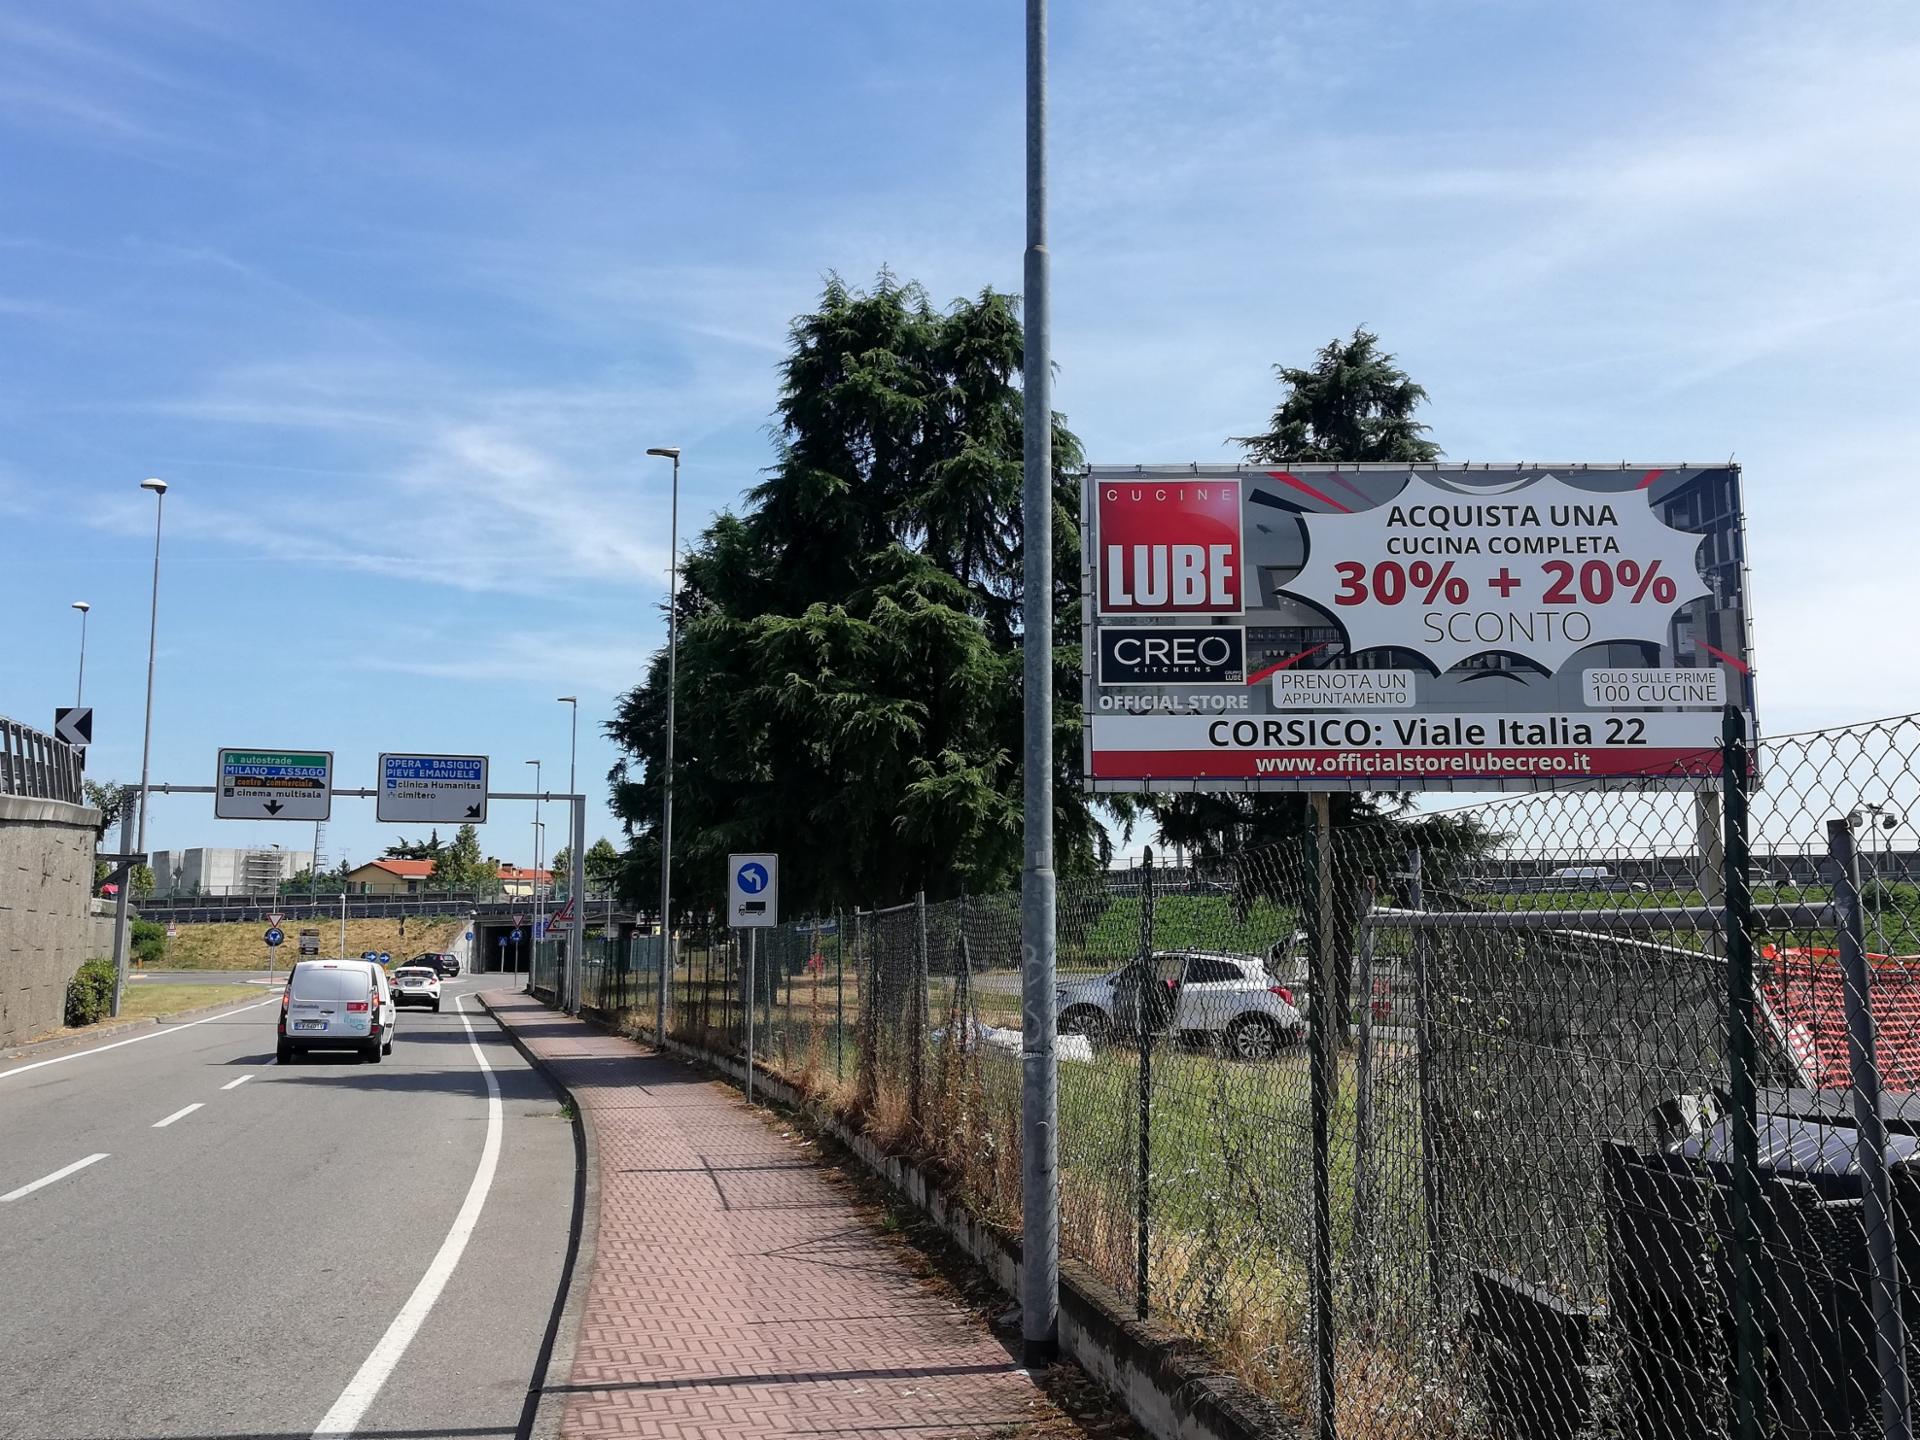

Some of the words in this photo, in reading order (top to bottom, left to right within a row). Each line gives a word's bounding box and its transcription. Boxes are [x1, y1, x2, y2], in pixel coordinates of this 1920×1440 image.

[1107, 489, 1232, 502] CUCINE
[1386, 504, 1541, 532] ACQUISTA
[1550, 504, 1619, 527] UNA
[1386, 536, 1481, 555] CUCINA
[1487, 536, 1621, 554] COMPLETA
[1107, 544, 1234, 606] LUBE
[1333, 560, 1470, 606] 30%
[1488, 567, 1522, 598] +
[1541, 559, 1677, 605] 20%
[1423, 611, 1592, 643] SCONTO
[1113, 636, 1231, 666] CREO
[1281, 674, 1375, 689] PRENOTA
[1378, 673, 1407, 689] UN
[1591, 672, 1628, 684] SOLO
[1632, 672, 1672, 684] SULLE
[1675, 672, 1716, 684] PRIME
[1282, 692, 1407, 704] APPUNTAMENTO
[1592, 686, 1630, 702] 100
[1637, 685, 1717, 702] CUCINE
[1099, 695, 1186, 710] OFFICIAL
[1188, 694, 1249, 709] STORE
[1208, 719, 1382, 747] CORSICO:
[1392, 717, 1486, 746] Viale
[1498, 716, 1593, 745] Italia
[1604, 718, 1648, 745] 22
[240, 756, 293, 765] autostrade
[387, 759, 422, 768] OPERA
[433, 760, 480, 769] BASIGLIO
[1255, 752, 1592, 773] www.officialstorelubecreo.it
[225, 766, 268, 775] MILANO
[279, 767, 325, 776] ASSAGO
[387, 768, 415, 777] PIEVE
[419, 769, 475, 778] EMANUELE
[237, 788, 272, 797] cinema
[276, 789, 322, 798] multisala
[398, 781, 429, 789] clinica
[431, 781, 481, 790] Humanitas
[398, 791, 437, 799] cimitero
